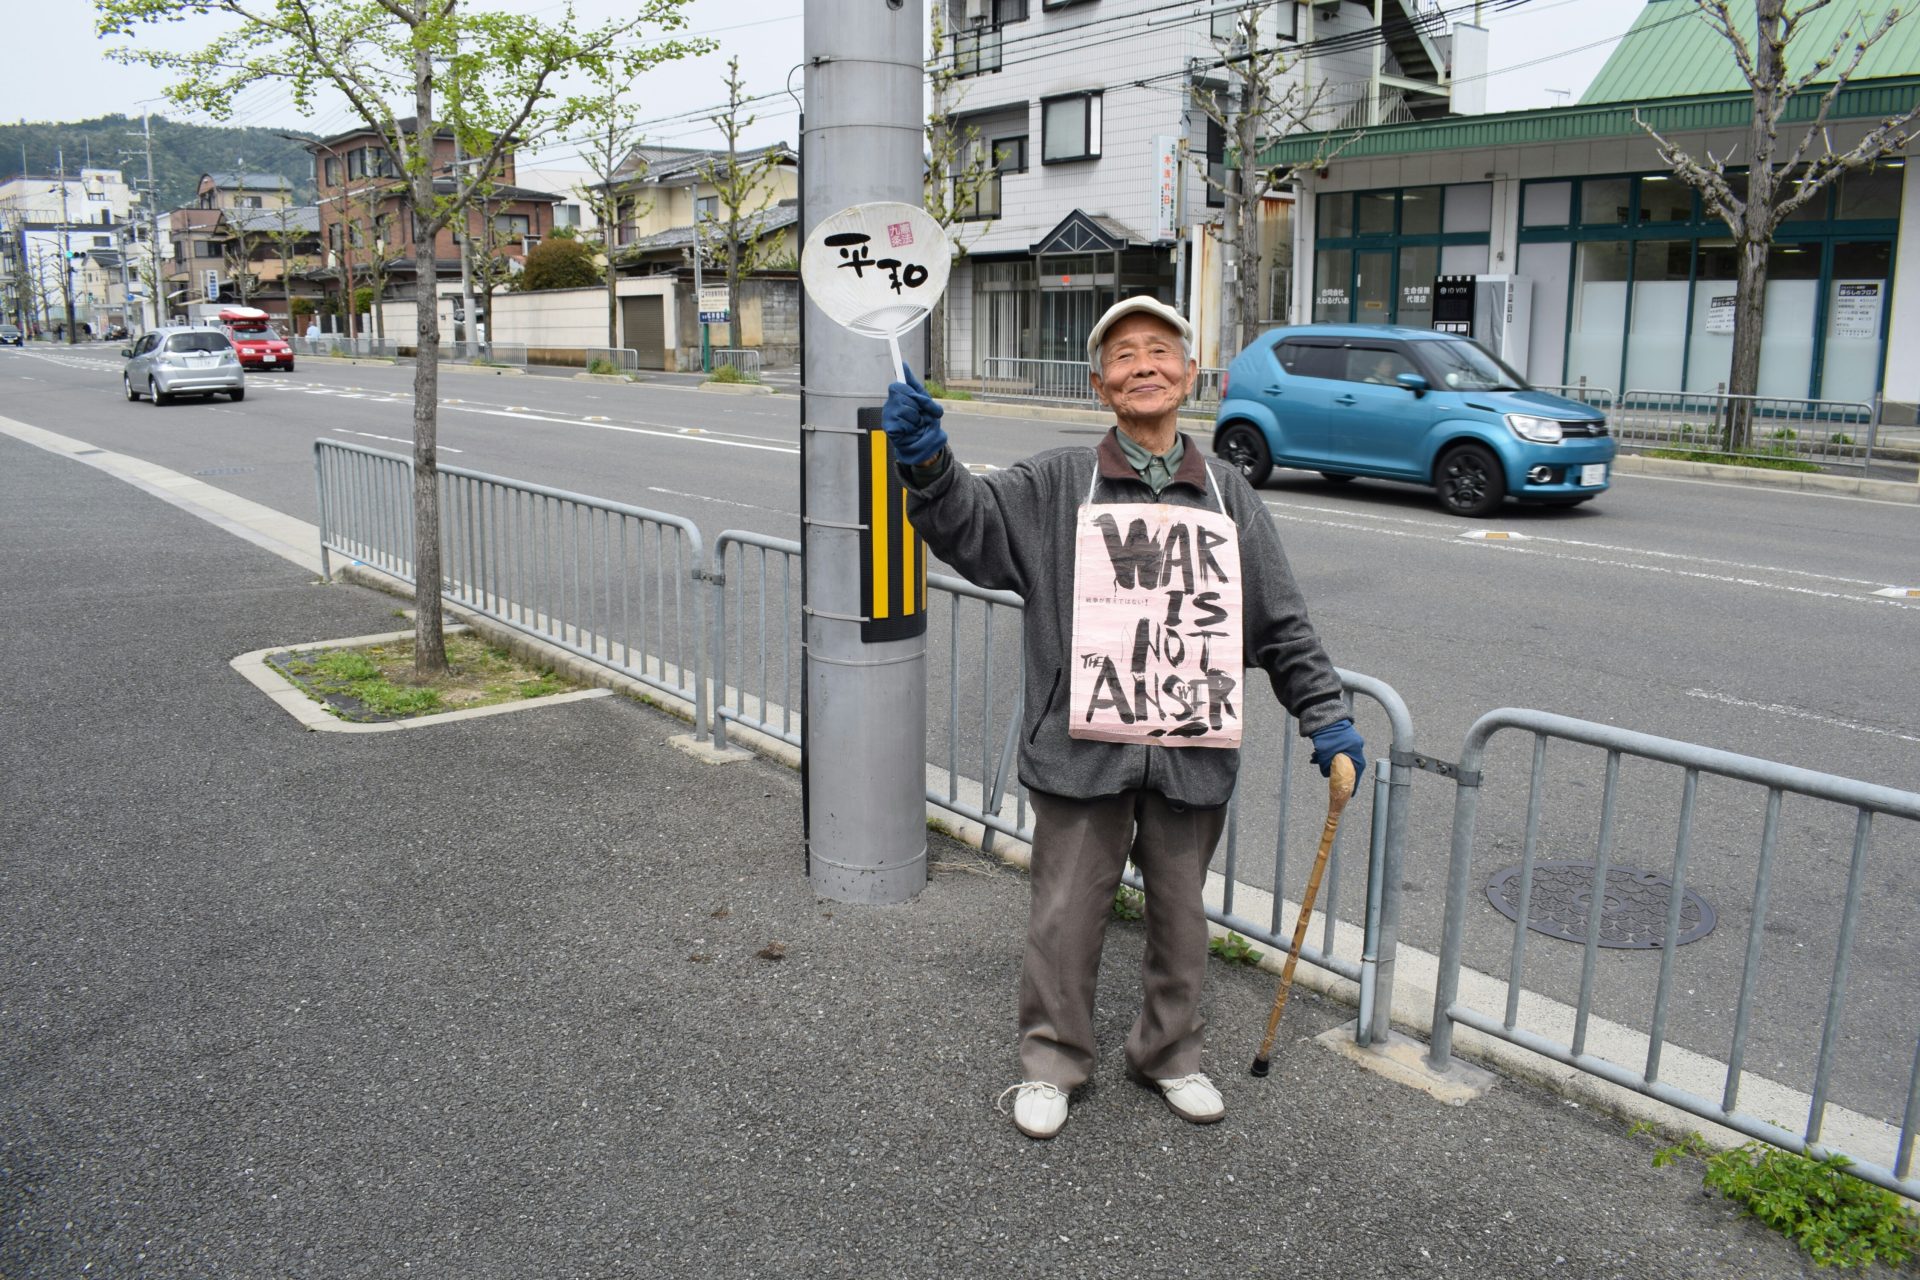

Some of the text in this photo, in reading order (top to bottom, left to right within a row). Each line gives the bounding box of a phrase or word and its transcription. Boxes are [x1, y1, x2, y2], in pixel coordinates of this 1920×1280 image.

[824, 233, 929, 296] 平和
[1406, 295, 1427, 304] 代理店
[1091, 513, 1229, 596] WAR
[1164, 590, 1229, 628] IS
[1081, 652, 1103, 669] THE
[1130, 617, 1231, 676] NOT
